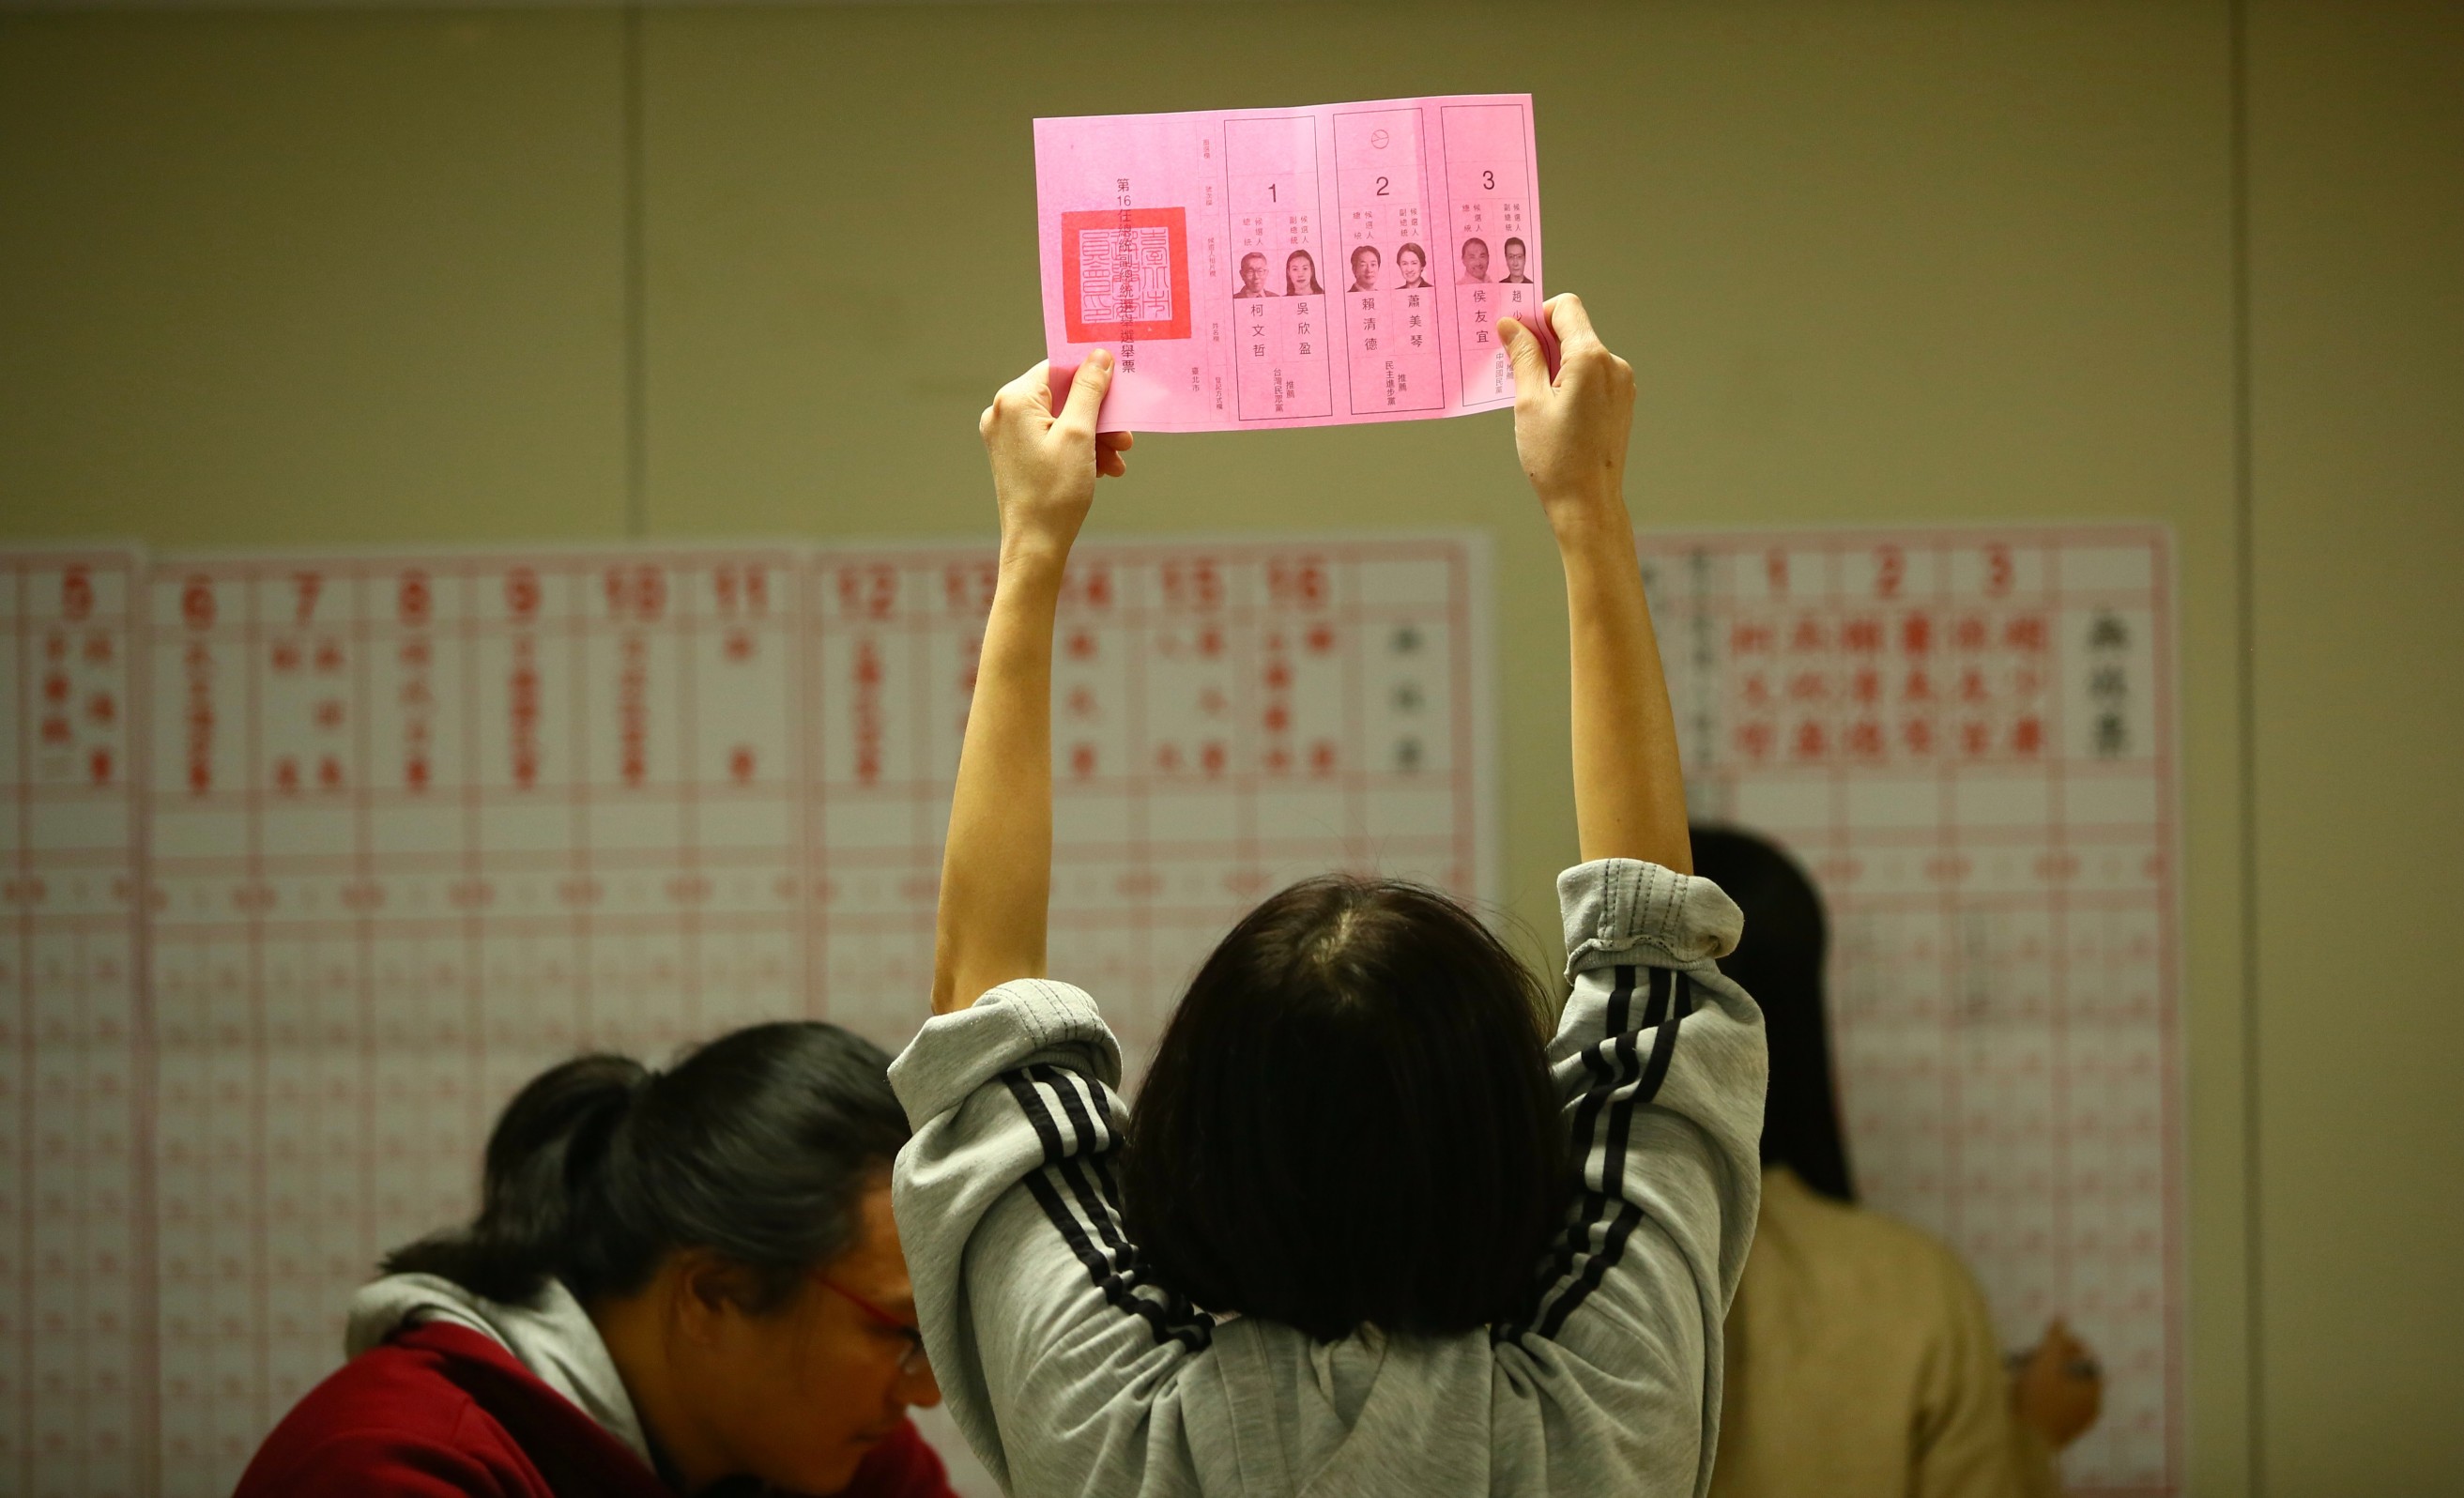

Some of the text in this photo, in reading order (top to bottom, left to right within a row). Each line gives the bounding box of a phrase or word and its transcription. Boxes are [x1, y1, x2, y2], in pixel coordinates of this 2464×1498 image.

[1268, 183, 1277, 203] 1
[1376, 176, 1389, 196] 2
[1483, 170, 1494, 190] 3
[1250, 303, 1266, 357] 柯文哲
[1297, 301, 1311, 355] 吳欣盈
[1362, 298, 1378, 351] 賴清德
[1408, 295, 1423, 347] 蕭美琴
[1474, 290, 1489, 344] 侯友宜
[1512, 290, 1523, 321] 趙少
[1385, 360, 1396, 405] 民主進步黨
[839, 565, 895, 620] 12
[1875, 543, 1905, 599] 2
[292, 571, 322, 626] 7
